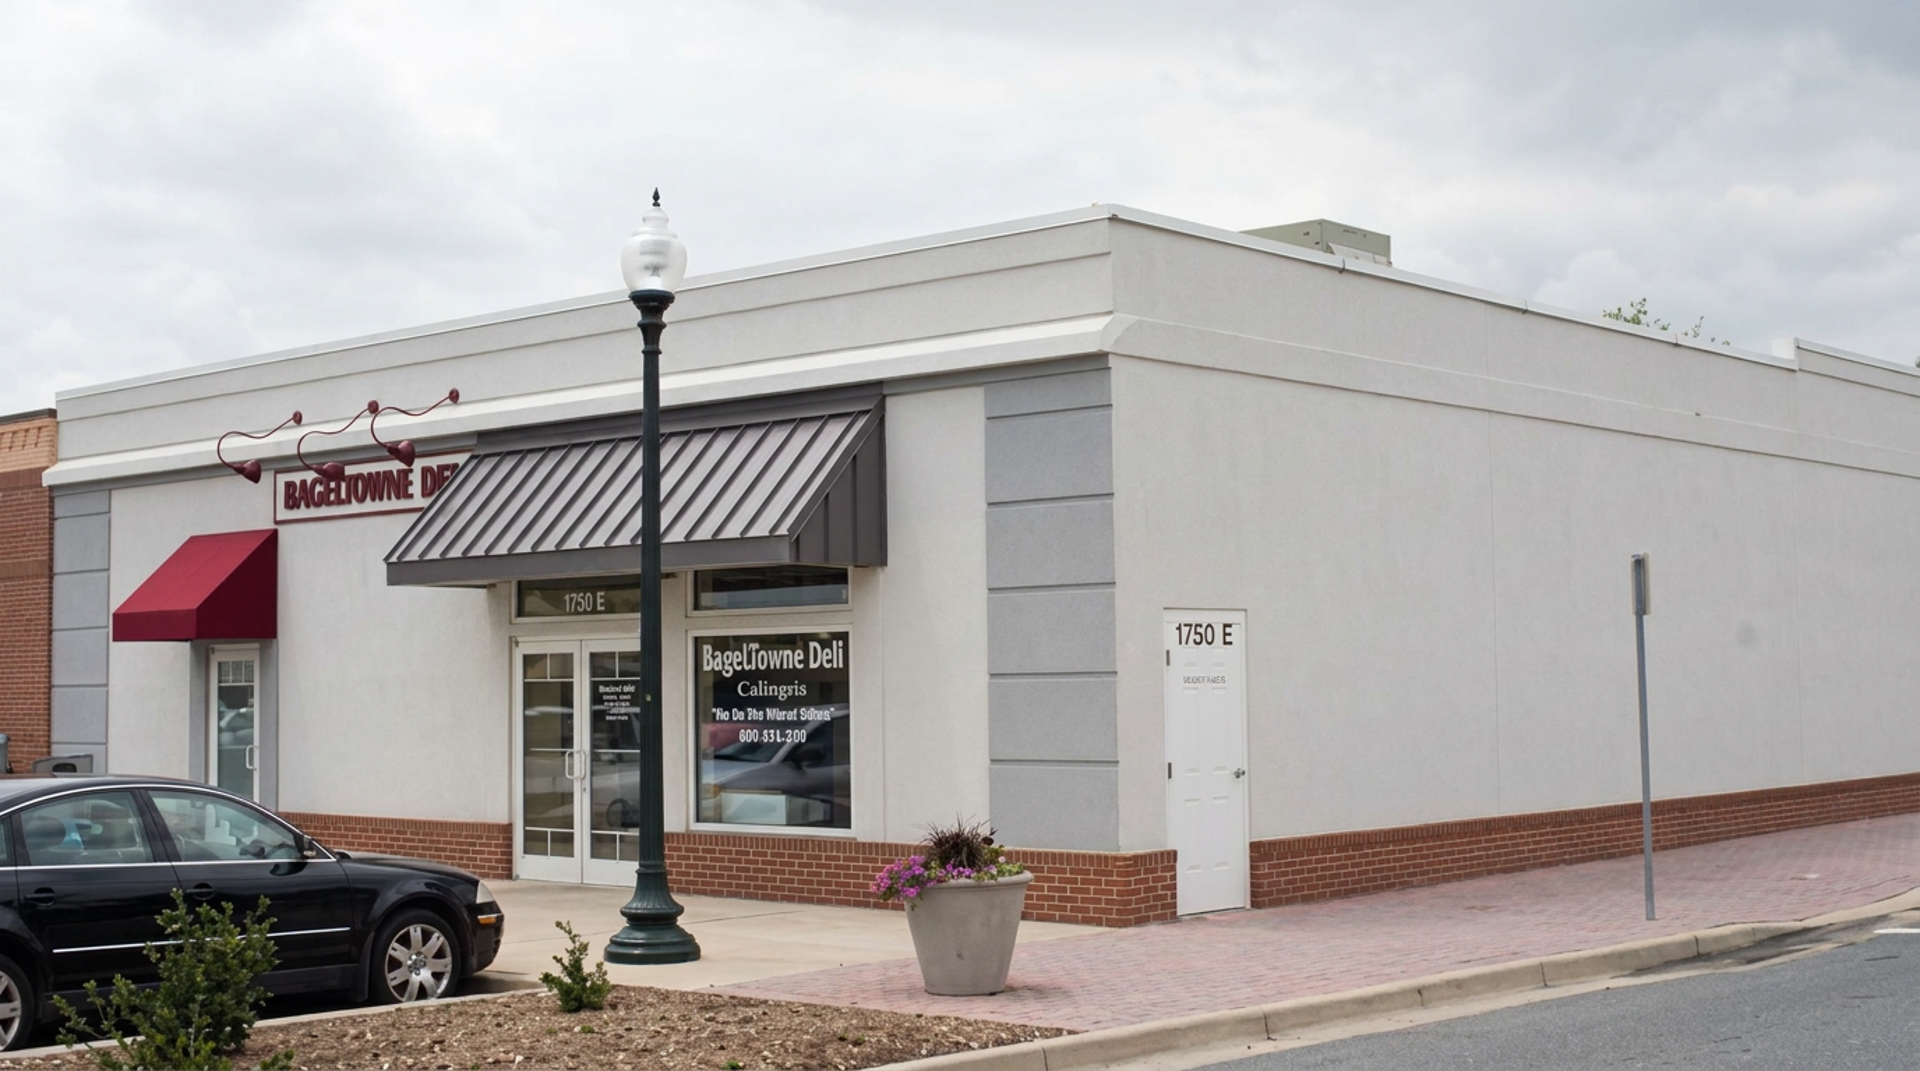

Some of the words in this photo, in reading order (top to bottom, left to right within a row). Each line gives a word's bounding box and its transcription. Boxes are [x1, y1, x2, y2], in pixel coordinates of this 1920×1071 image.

[284, 468, 414, 510] BAGELTOWNE
[564, 592, 593, 612] 1750
[597, 591, 605, 611] E
[1176, 623, 1215, 646] 1750
[1222, 623, 1233, 646] E
[702, 642, 804, 678] BagelTowne
[808, 640, 844, 669] Deli
